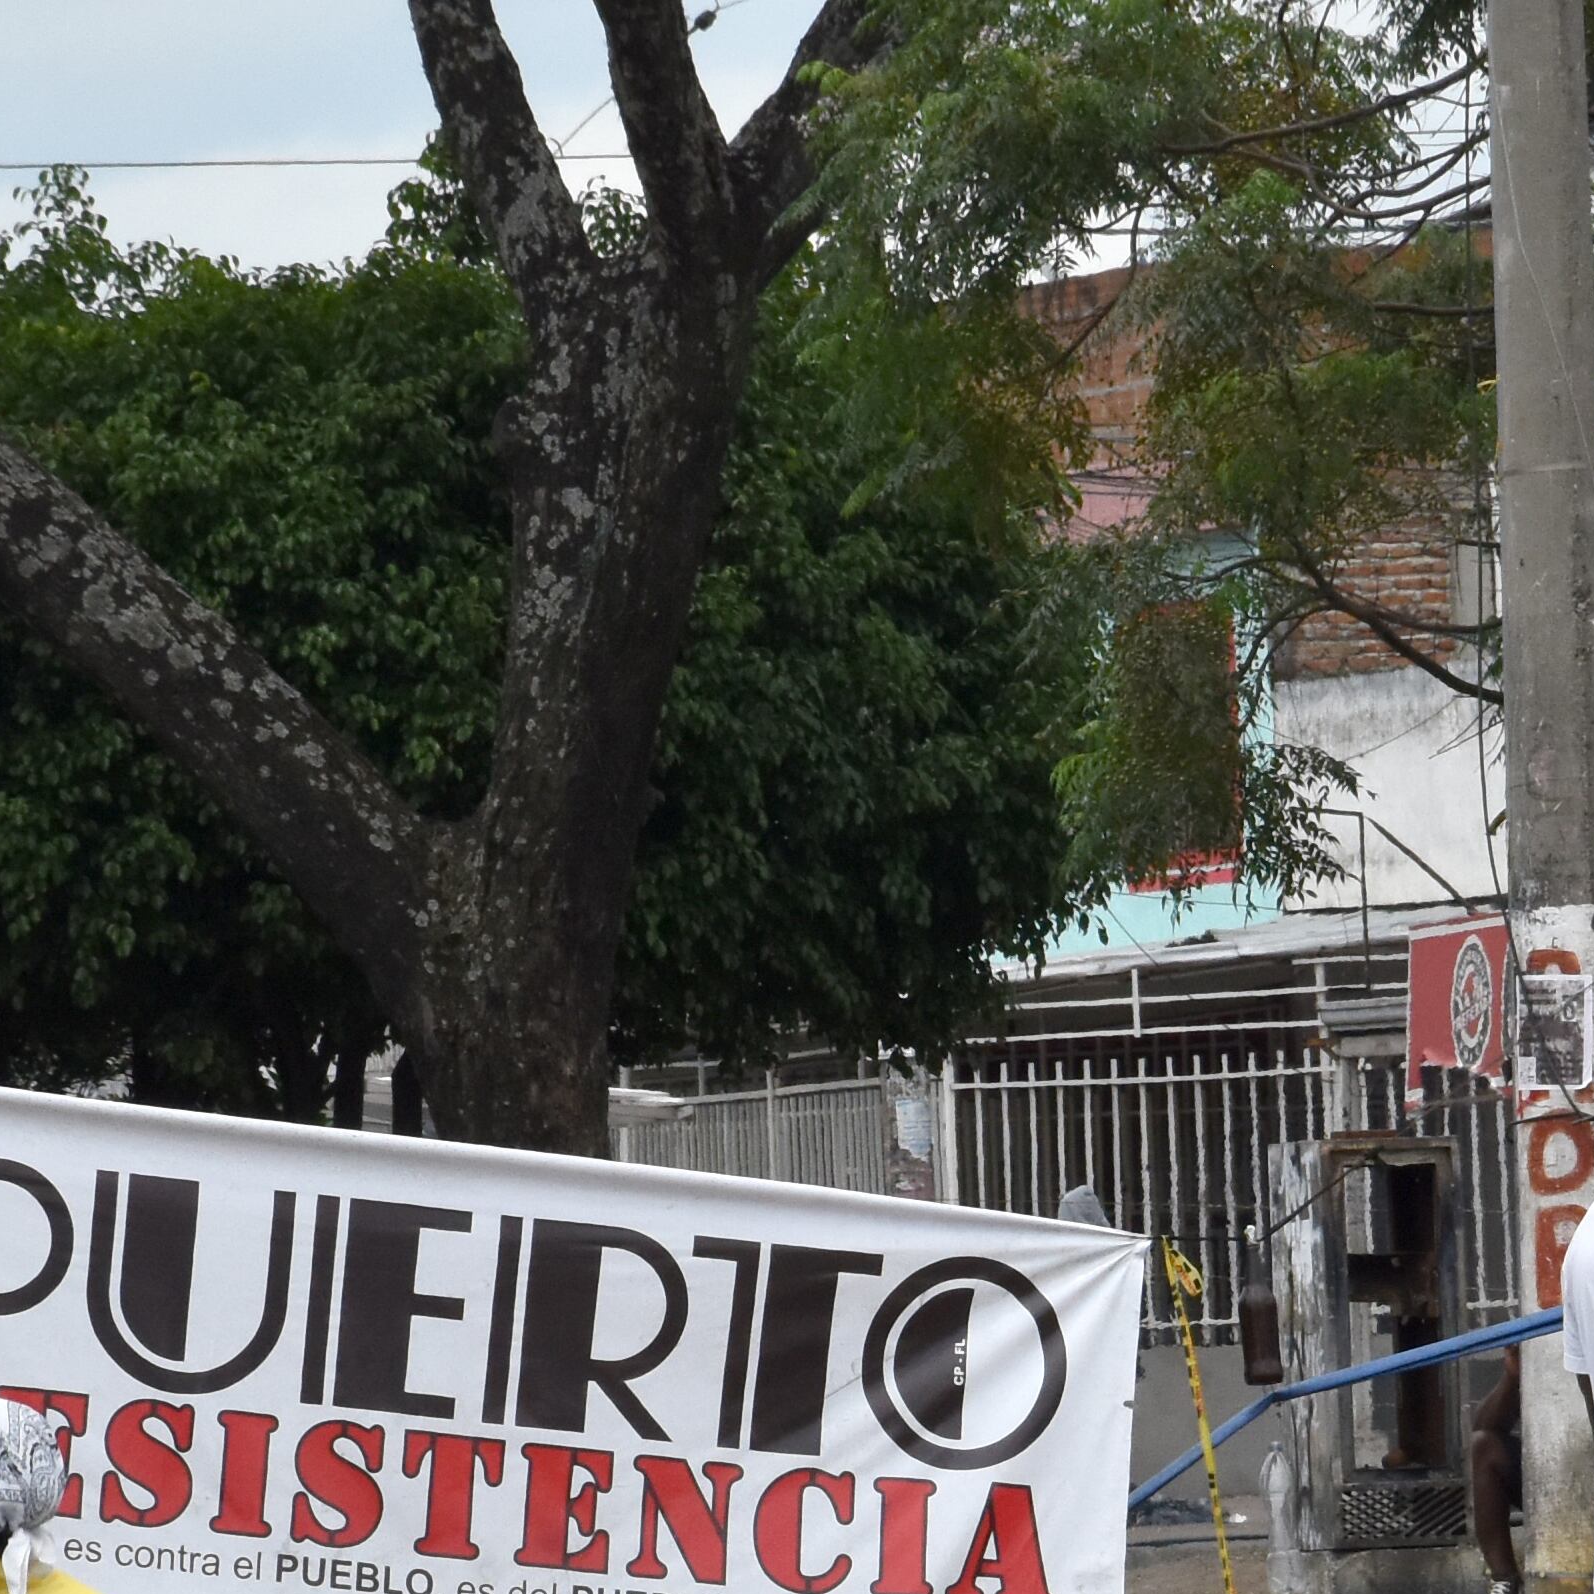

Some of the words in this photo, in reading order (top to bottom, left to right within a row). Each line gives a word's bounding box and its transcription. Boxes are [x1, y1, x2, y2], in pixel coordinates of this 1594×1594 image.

[954, 1338, 966, 1355] FL
[953, 1365, 965, 1387] CP
[63, 1536, 103, 1563] es
[114, 1542, 221, 1577] contra
[233, 1551, 263, 1580] el
